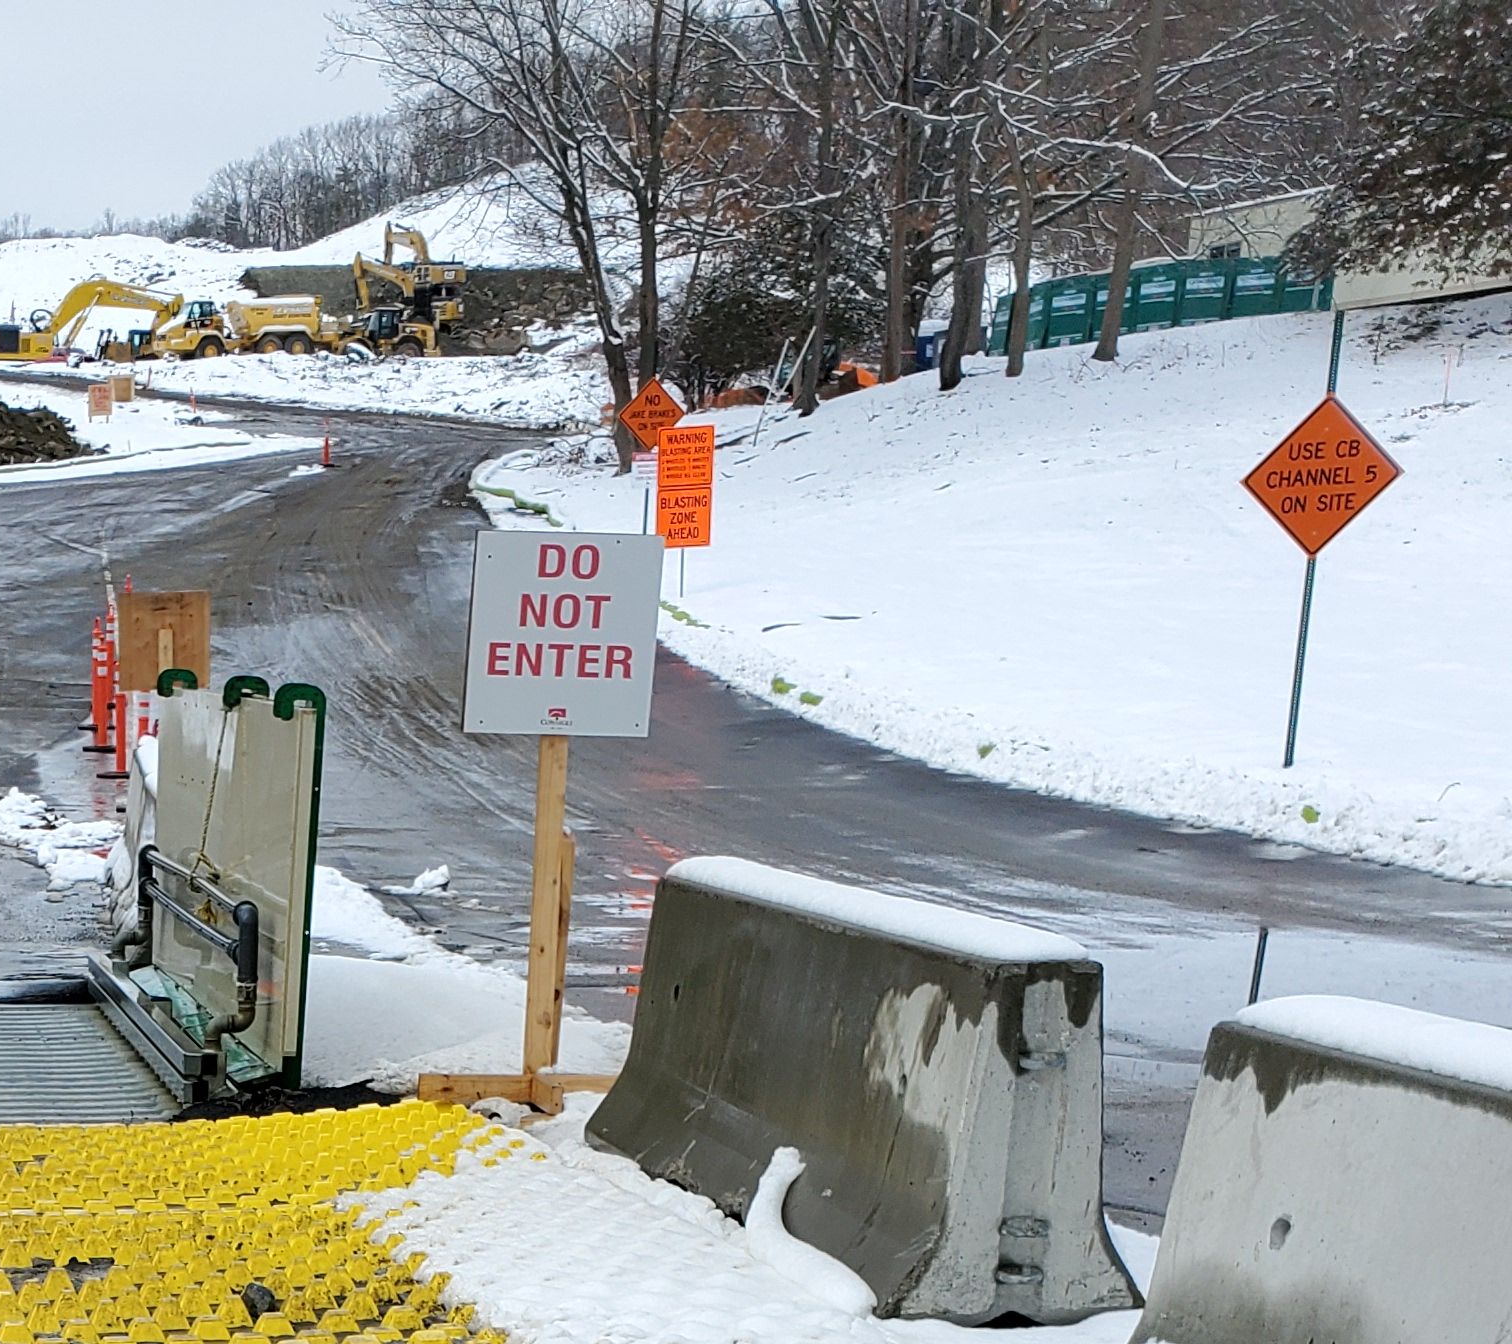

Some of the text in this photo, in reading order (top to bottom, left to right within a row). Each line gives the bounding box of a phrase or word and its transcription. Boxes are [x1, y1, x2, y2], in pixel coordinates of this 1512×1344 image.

[645, 394, 661, 407] NO
[666, 432, 708, 445] WARNING
[1289, 439, 1361, 461] USE CB
[1266, 465, 1378, 489] CHANNEL 5
[660, 495, 708, 510] BLASTING
[1281, 492, 1356, 514] ON SITE
[669, 511, 697, 525] ZONE
[666, 526, 700, 541] AHEAD
[538, 543, 600, 580] DO
[519, 593, 612, 630] NOT
[487, 642, 633, 680] ENTER
